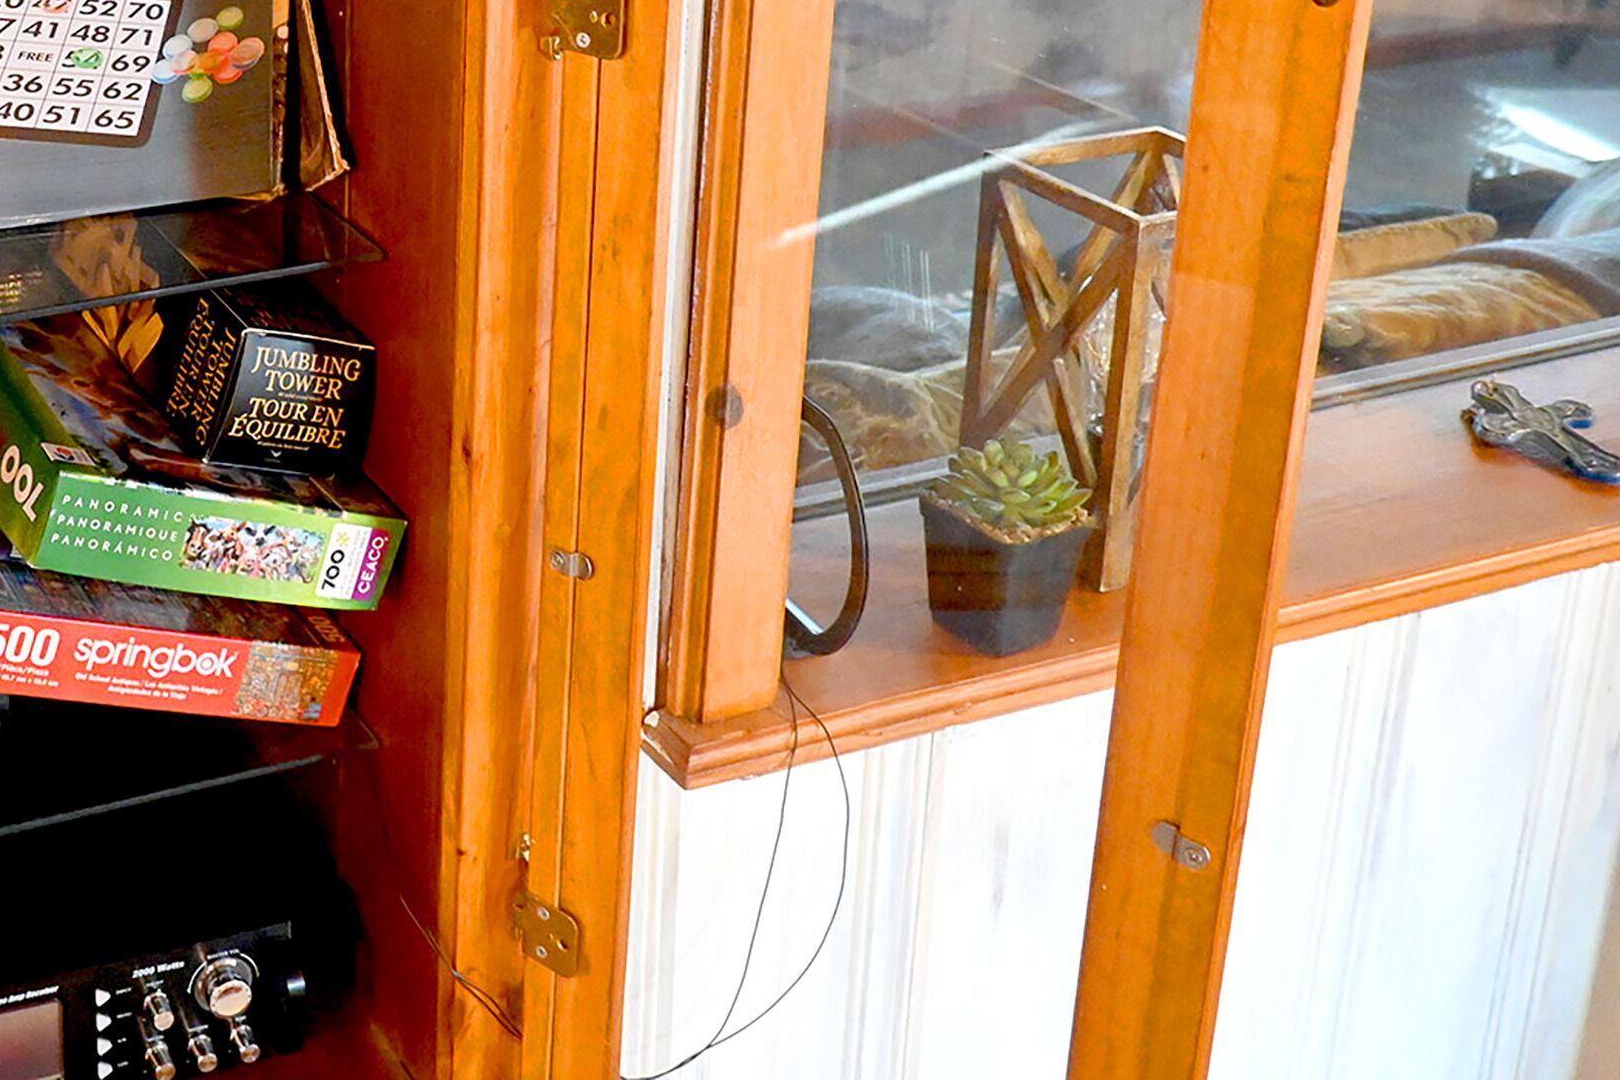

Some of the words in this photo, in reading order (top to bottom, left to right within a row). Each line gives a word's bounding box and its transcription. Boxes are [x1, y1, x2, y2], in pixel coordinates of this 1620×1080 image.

[78, 0, 118, 18] 52
[127, 2, 164, 20] 70
[22, 20, 60, 38] 41
[70, 25, 110, 43] 48
[119, 28, 154, 46] 71
[17, 50, 54, 63] FREE
[111, 55, 150, 73] 69
[2, 74, 44, 93] 36
[52, 78, 95, 97] 55
[103, 83, 142, 101] 62
[42, 106, 81, 125] 51
[93, 110, 135, 130] 65
[251, 345, 361, 382] JUMBLING
[264, 369, 342, 401] TOWER
[249, 397, 308, 422] TOUR
[310, 405, 345, 427] EN
[228, 413, 346, 449] ÉQUILIBRE
[61, 494, 184, 523] PANORAMIC
[56, 514, 179, 543] PANORAMIQUE
[50, 533, 174, 561] PANORÁMICO
[321, 549, 345, 590] 700
[357, 536, 385, 594] CEACO
[73, 636, 237, 678] springbok
[132, 966, 156, 979] 2000
[156, 960, 186, 974] Watts
